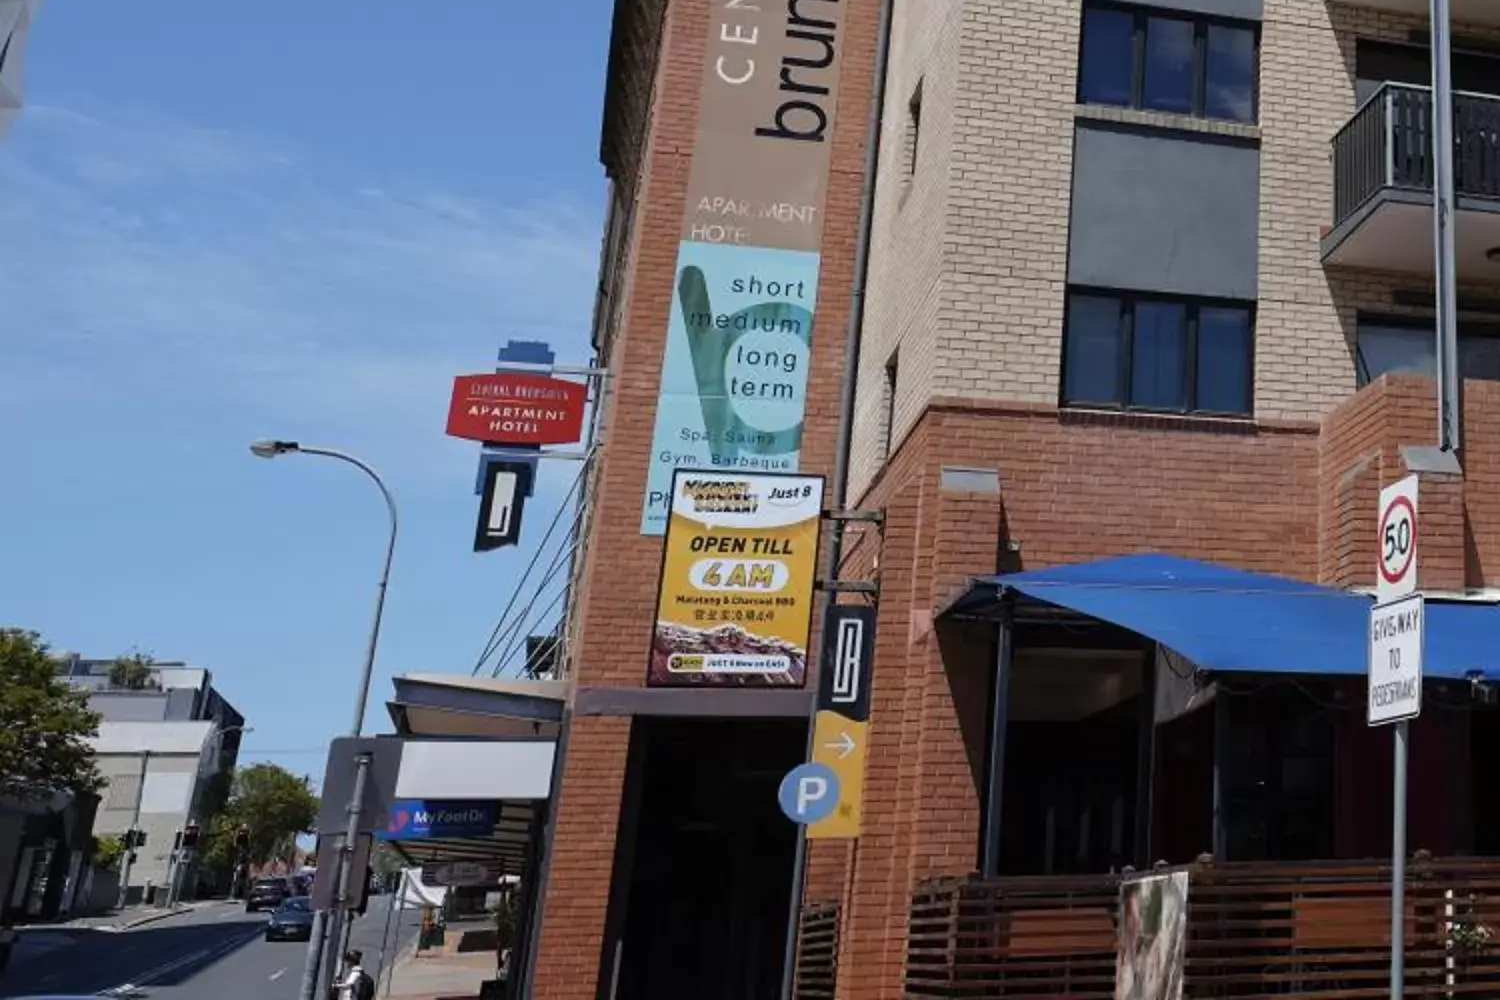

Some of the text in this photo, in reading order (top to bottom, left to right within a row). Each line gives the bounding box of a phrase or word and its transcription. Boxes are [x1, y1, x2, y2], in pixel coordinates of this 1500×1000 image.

[731, 275, 804, 299] short
[689, 312, 801, 334] medium
[737, 345, 797, 373] long
[731, 377, 794, 399] term
[468, 405, 565, 421] APARTMENT
[489, 421, 538, 434] HOTEL
[768, 487, 801, 500] Just
[690, 535, 793, 555] OPEN TILL
[1385, 518, 1410, 562] 50
[725, 563, 775, 589] AM
[1397, 608, 1419, 634] WAY
[1388, 647, 1401, 670] TO
[797, 777, 827, 815] P
